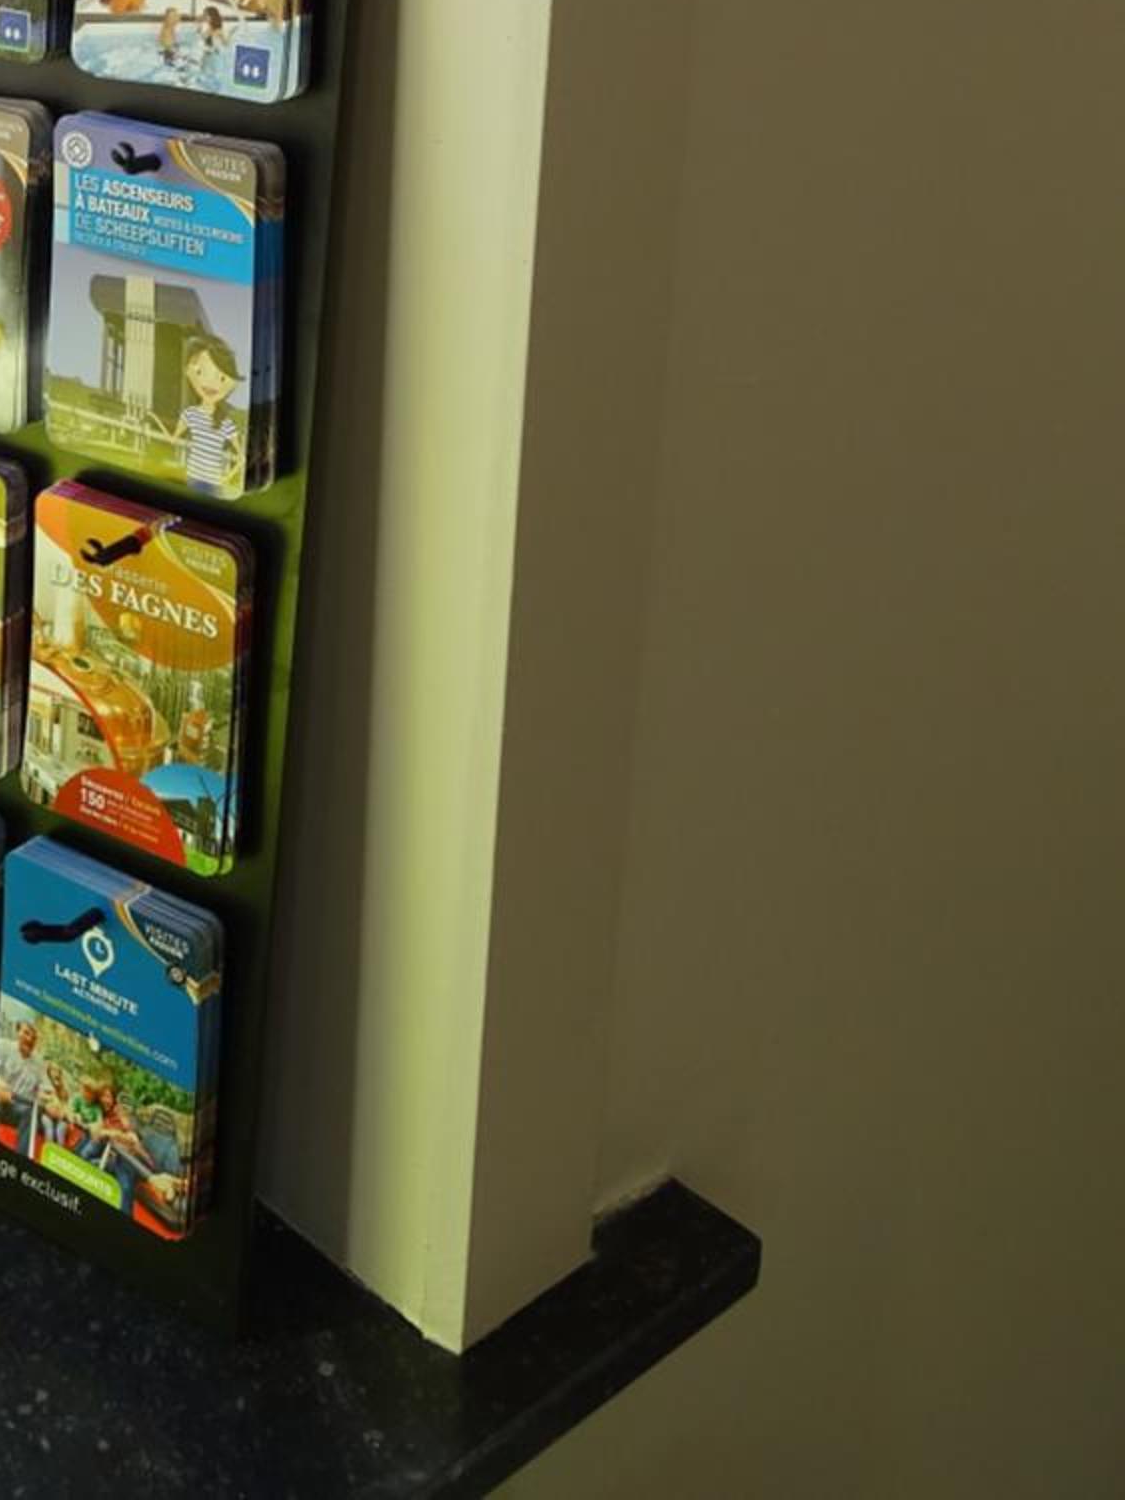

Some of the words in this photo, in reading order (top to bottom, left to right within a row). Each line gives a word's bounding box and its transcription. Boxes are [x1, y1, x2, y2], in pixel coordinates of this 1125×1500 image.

[200, 153, 249, 174] VISITES
[75, 173, 99, 193] LES
[102, 179, 194, 213] ASCENSEURS
[88, 196, 150, 224] BATEAUX
[50, 563, 104, 598] DES
[110, 579, 219, 639] FAGNES
[81, 787, 105, 811] 150
[144, 923, 191, 955] VISITES
[53, 962, 88, 988] LAST
[89, 980, 139, 1016] MINUTE
